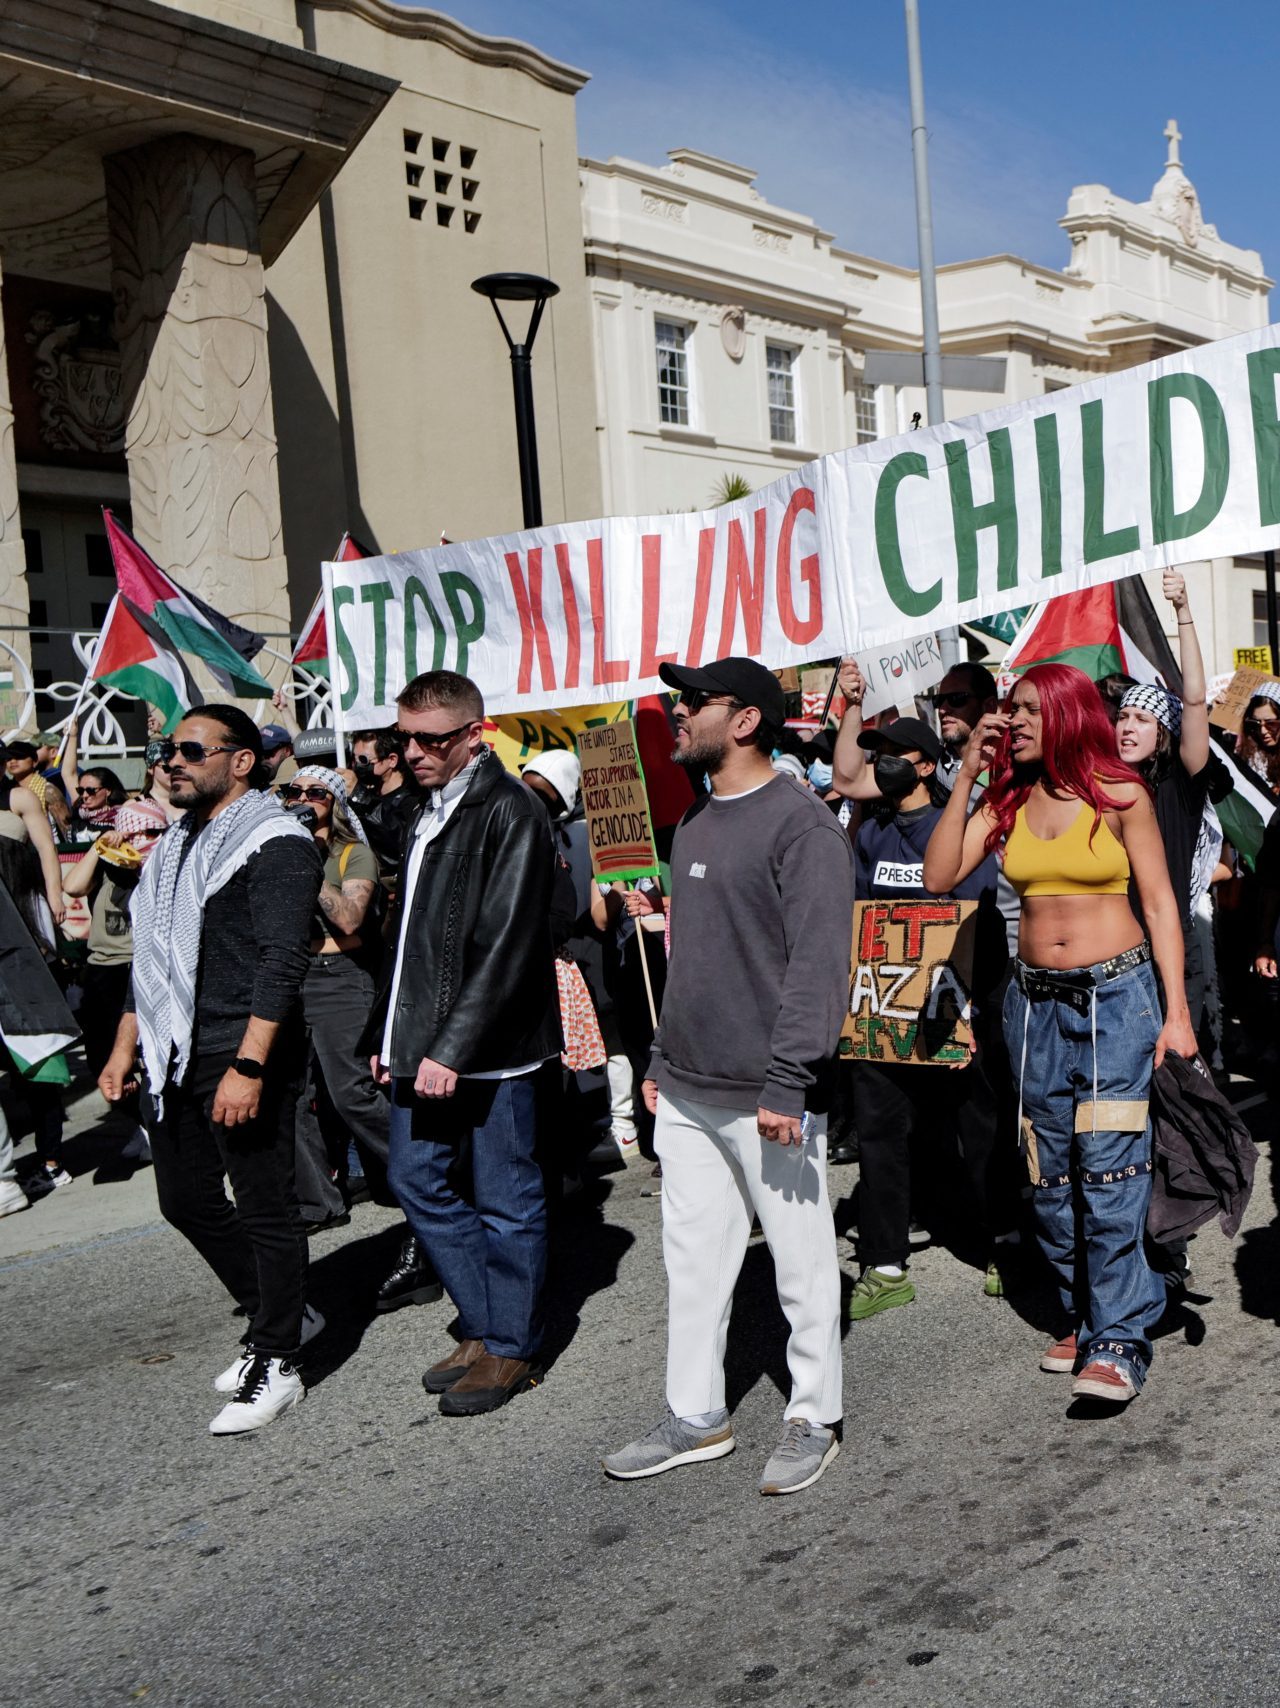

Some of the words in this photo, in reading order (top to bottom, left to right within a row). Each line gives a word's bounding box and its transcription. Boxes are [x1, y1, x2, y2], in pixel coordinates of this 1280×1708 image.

[334, 570, 486, 711] STOP
[505, 487, 824, 695] KILLING
[880, 636, 941, 684] POWER
[1237, 648, 1267, 664] FREE
[578, 732, 592, 750] THE
[594, 728, 616, 747] UNITED
[610, 743, 636, 763] STATES
[583, 766, 599, 788] BEST
[587, 790, 612, 810] ACTOR
[613, 787, 626, 807] IN
[628, 785, 635, 804] A
[591, 810, 651, 848] GENOCIDE
[877, 866, 923, 883] PRESS
[859, 902, 960, 963] ET
[851, 960, 971, 1024] AZA
